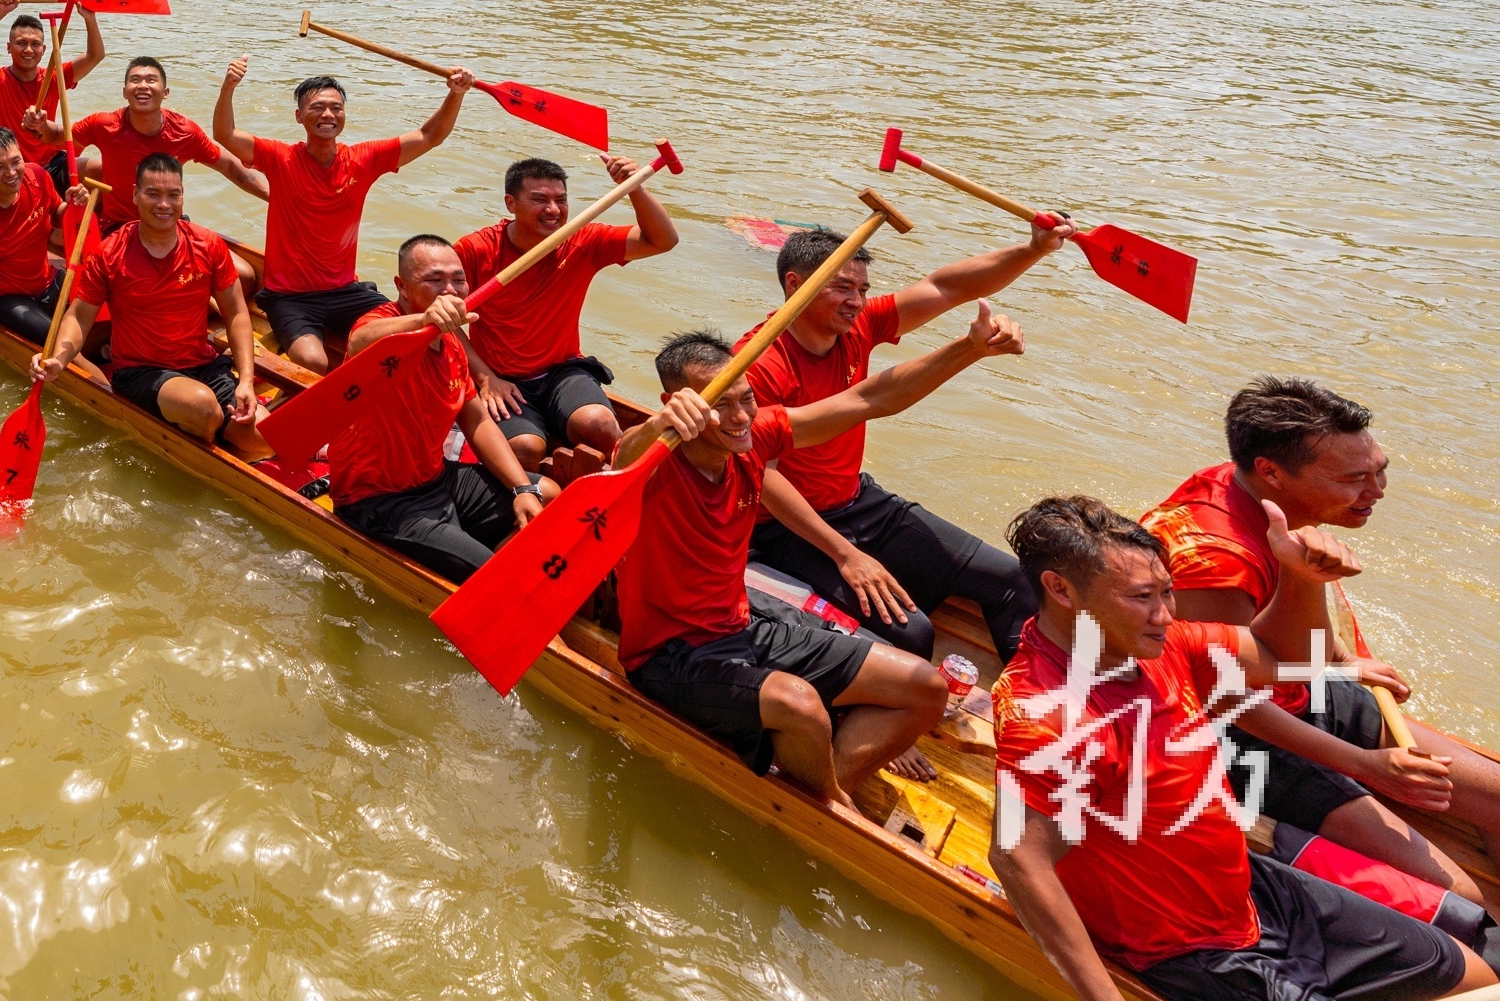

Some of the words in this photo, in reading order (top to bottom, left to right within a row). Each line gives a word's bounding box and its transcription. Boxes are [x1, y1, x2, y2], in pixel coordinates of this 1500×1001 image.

[379, 355, 402, 379] 朱
[342, 384, 361, 402] 9
[13, 430, 31, 451] 朱
[5, 468, 19, 486] 7
[577, 506, 608, 543] 朱
[542, 553, 568, 580] 8
